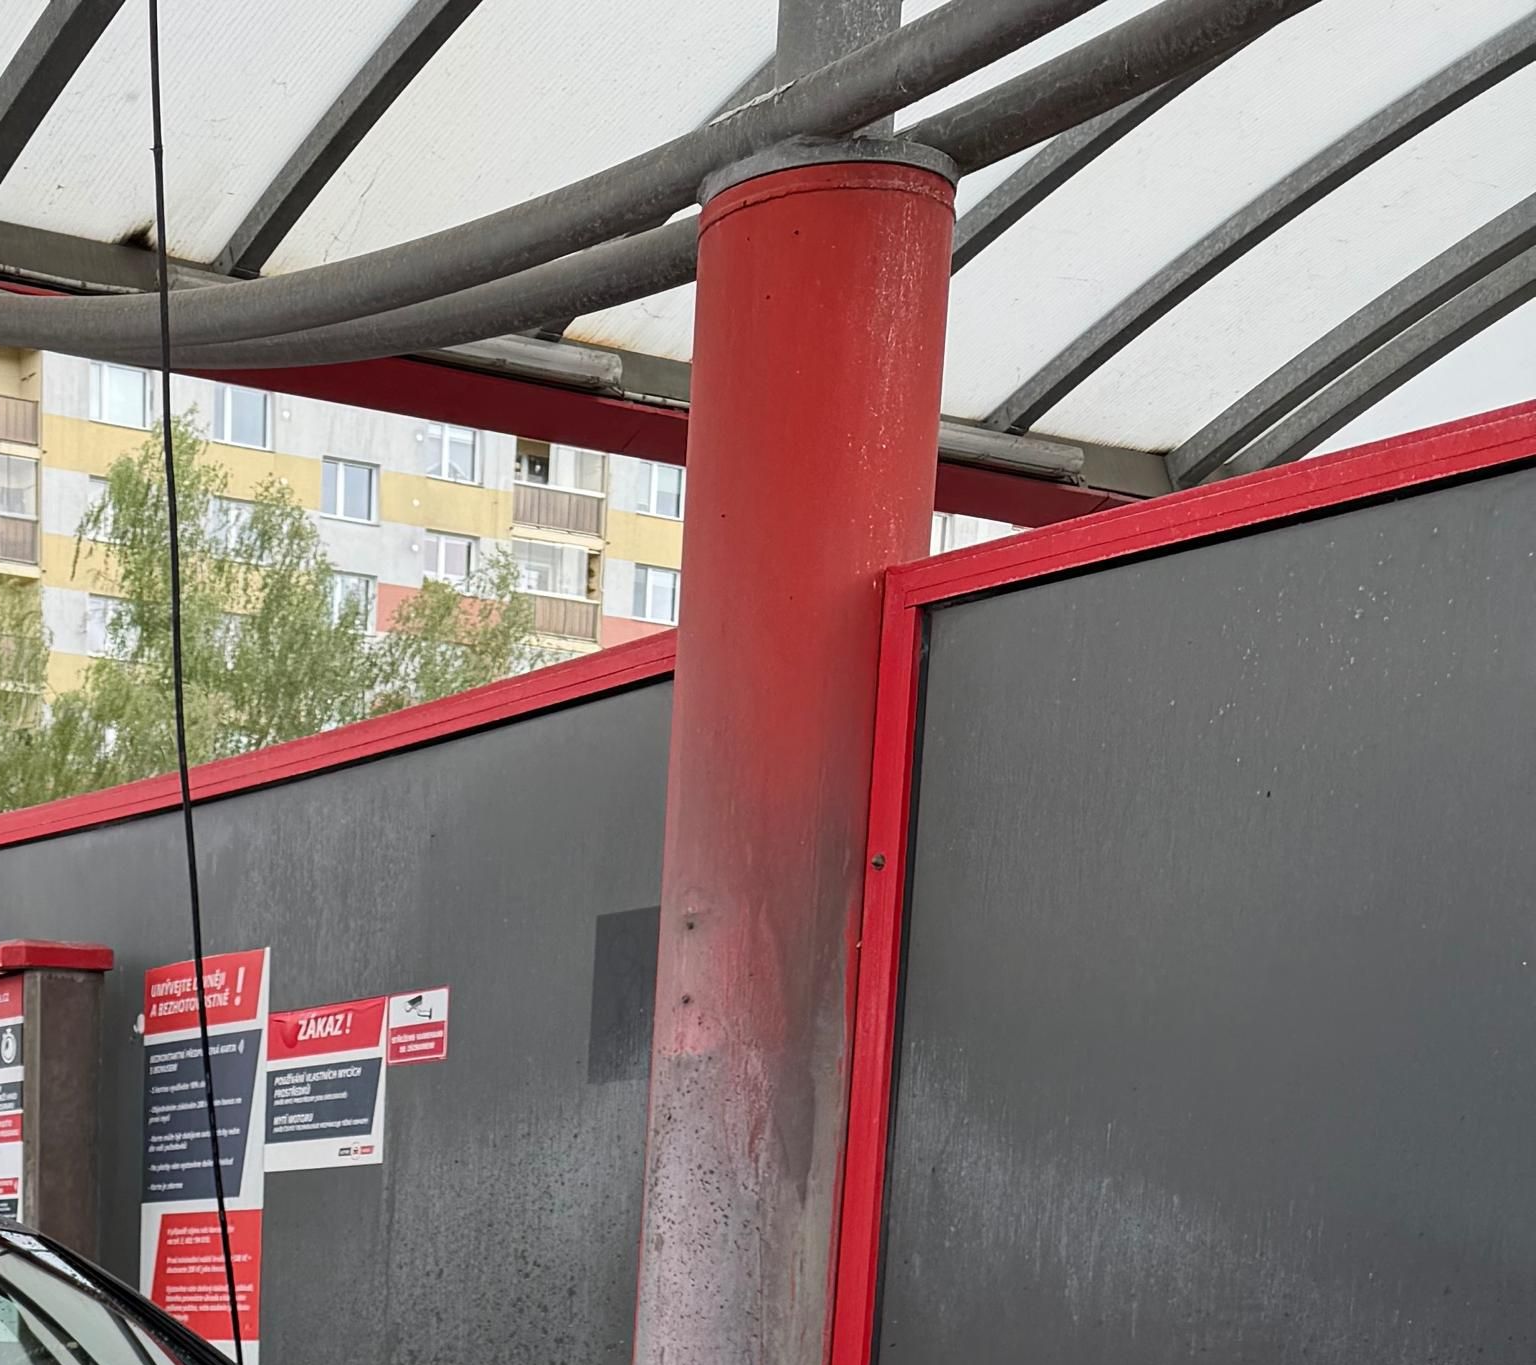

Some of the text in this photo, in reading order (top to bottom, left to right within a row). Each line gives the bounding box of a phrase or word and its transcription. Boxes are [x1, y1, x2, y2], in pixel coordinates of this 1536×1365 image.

[149, 1004, 157, 1018] A
[297, 1012, 353, 1041] ZÁKAZ !
